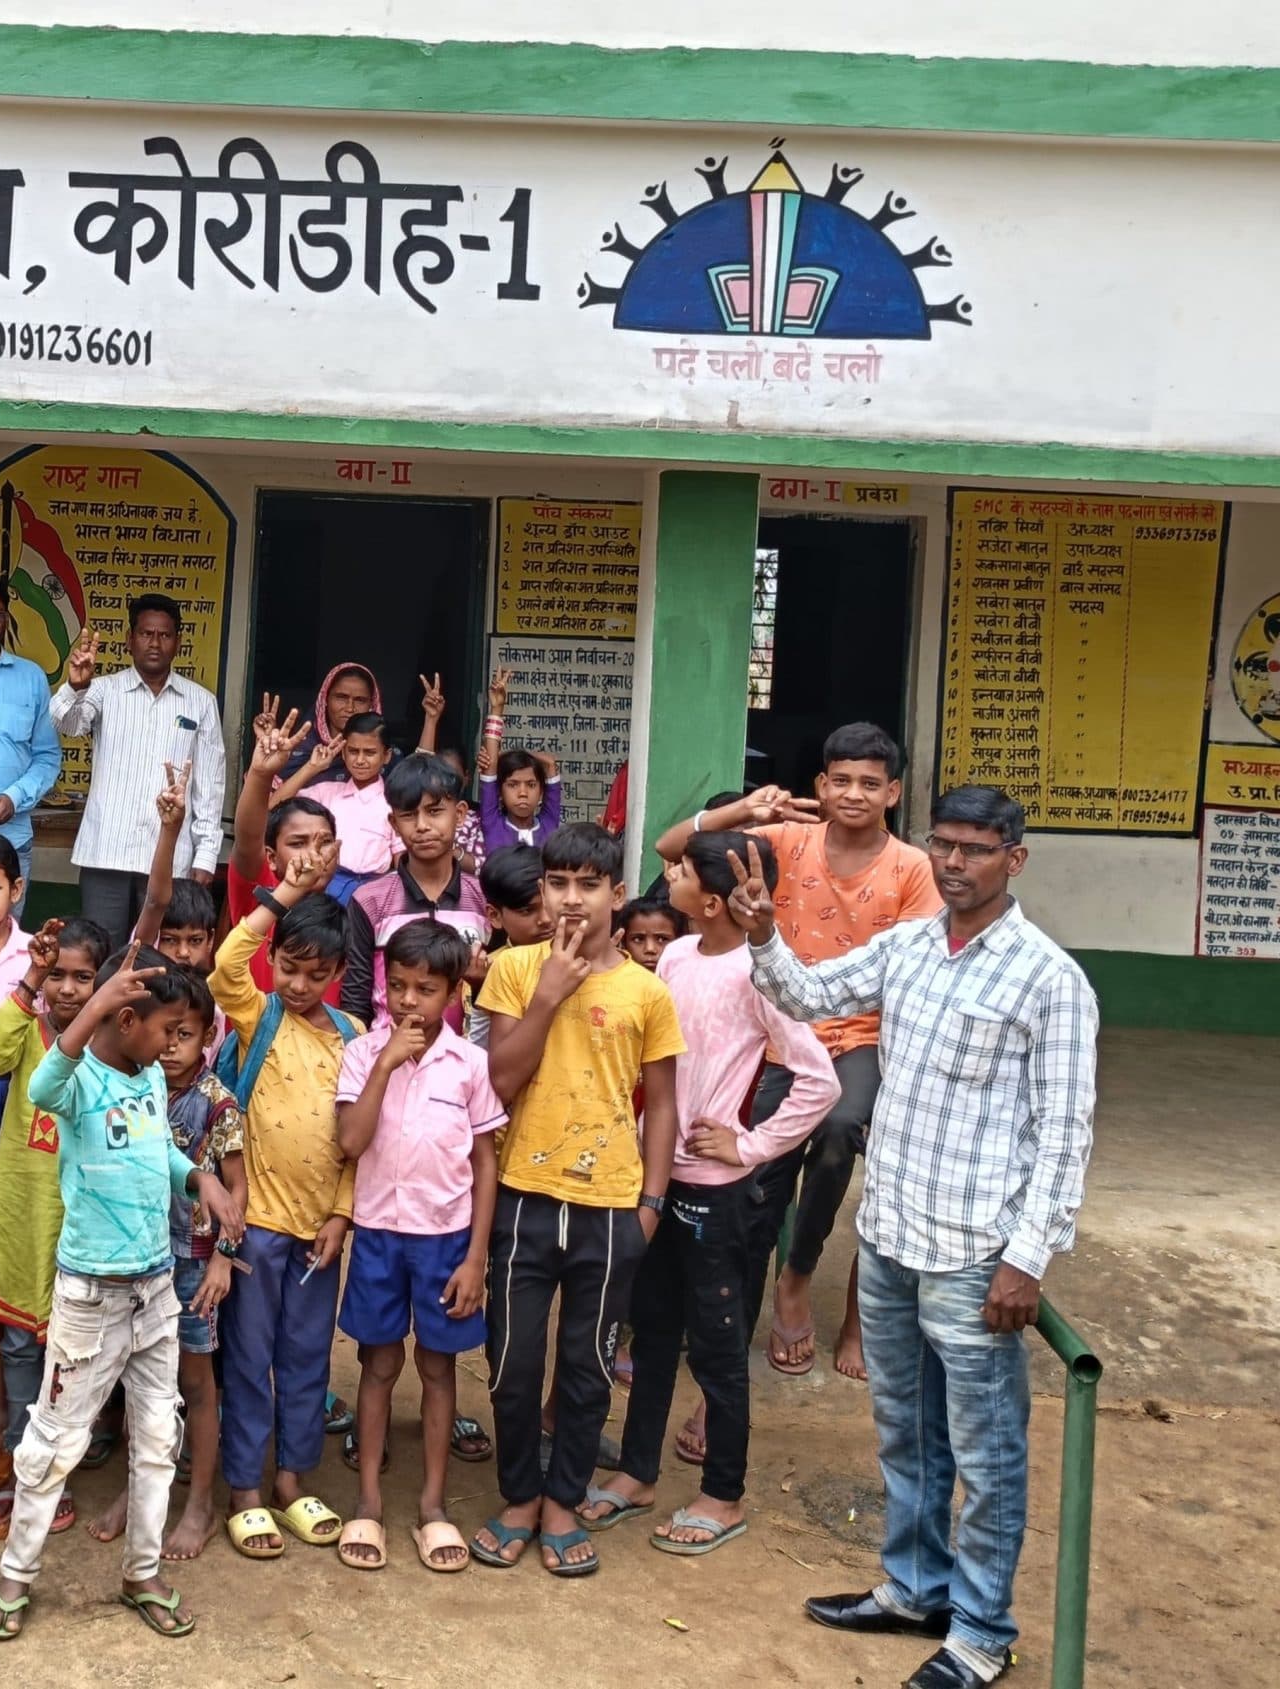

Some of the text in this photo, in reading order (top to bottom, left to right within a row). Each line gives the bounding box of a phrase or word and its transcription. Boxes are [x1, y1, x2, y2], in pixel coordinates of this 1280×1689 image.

[43, 465, 142, 492] राष्ट्र गान
[48, 500, 69, 514] जन
[89, 502, 105, 517] मन
[161, 507, 183, 521] जय
[974, 500, 1003, 514] SMC
[75, 524, 201, 544] भारत भाग्य विधाता
[139, 552, 178, 572] गुजरात
